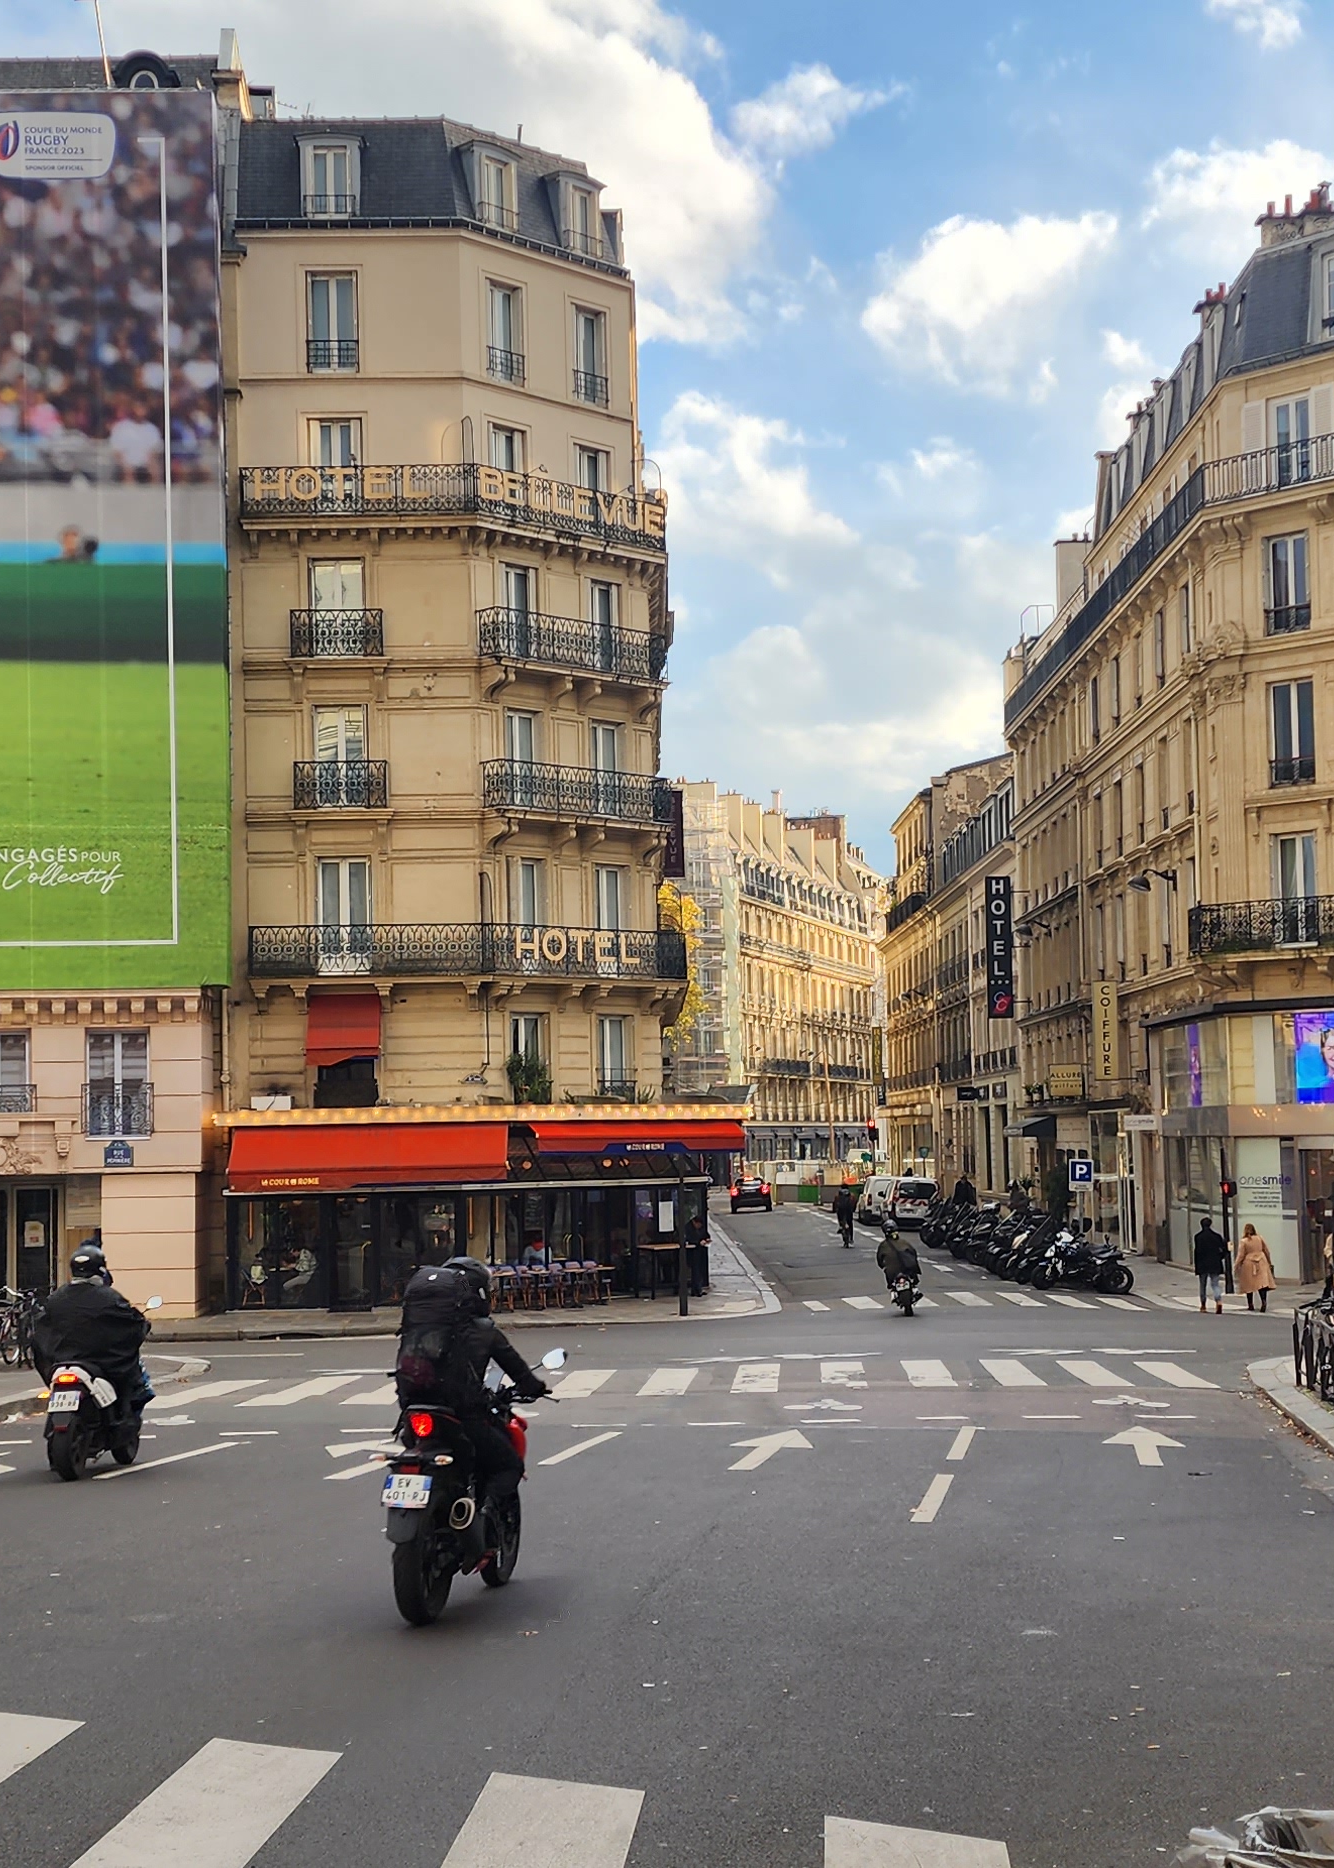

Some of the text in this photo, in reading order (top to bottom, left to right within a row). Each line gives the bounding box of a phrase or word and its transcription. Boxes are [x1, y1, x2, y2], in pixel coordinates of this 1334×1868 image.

[24, 135, 70, 146] RUGBY
[254, 464, 666, 537] HOTEL BELLEVUE
[80, 851, 121, 863] POUR
[2, 859, 124, 894] Collectif
[990, 879, 1007, 976] HOTEL
[514, 929, 640, 964] HOTEL
[1100, 985, 1112, 1076] COIFFURE
[1075, 1164, 1087, 1179] P
[1239, 1173, 1292, 1185] onesmile
